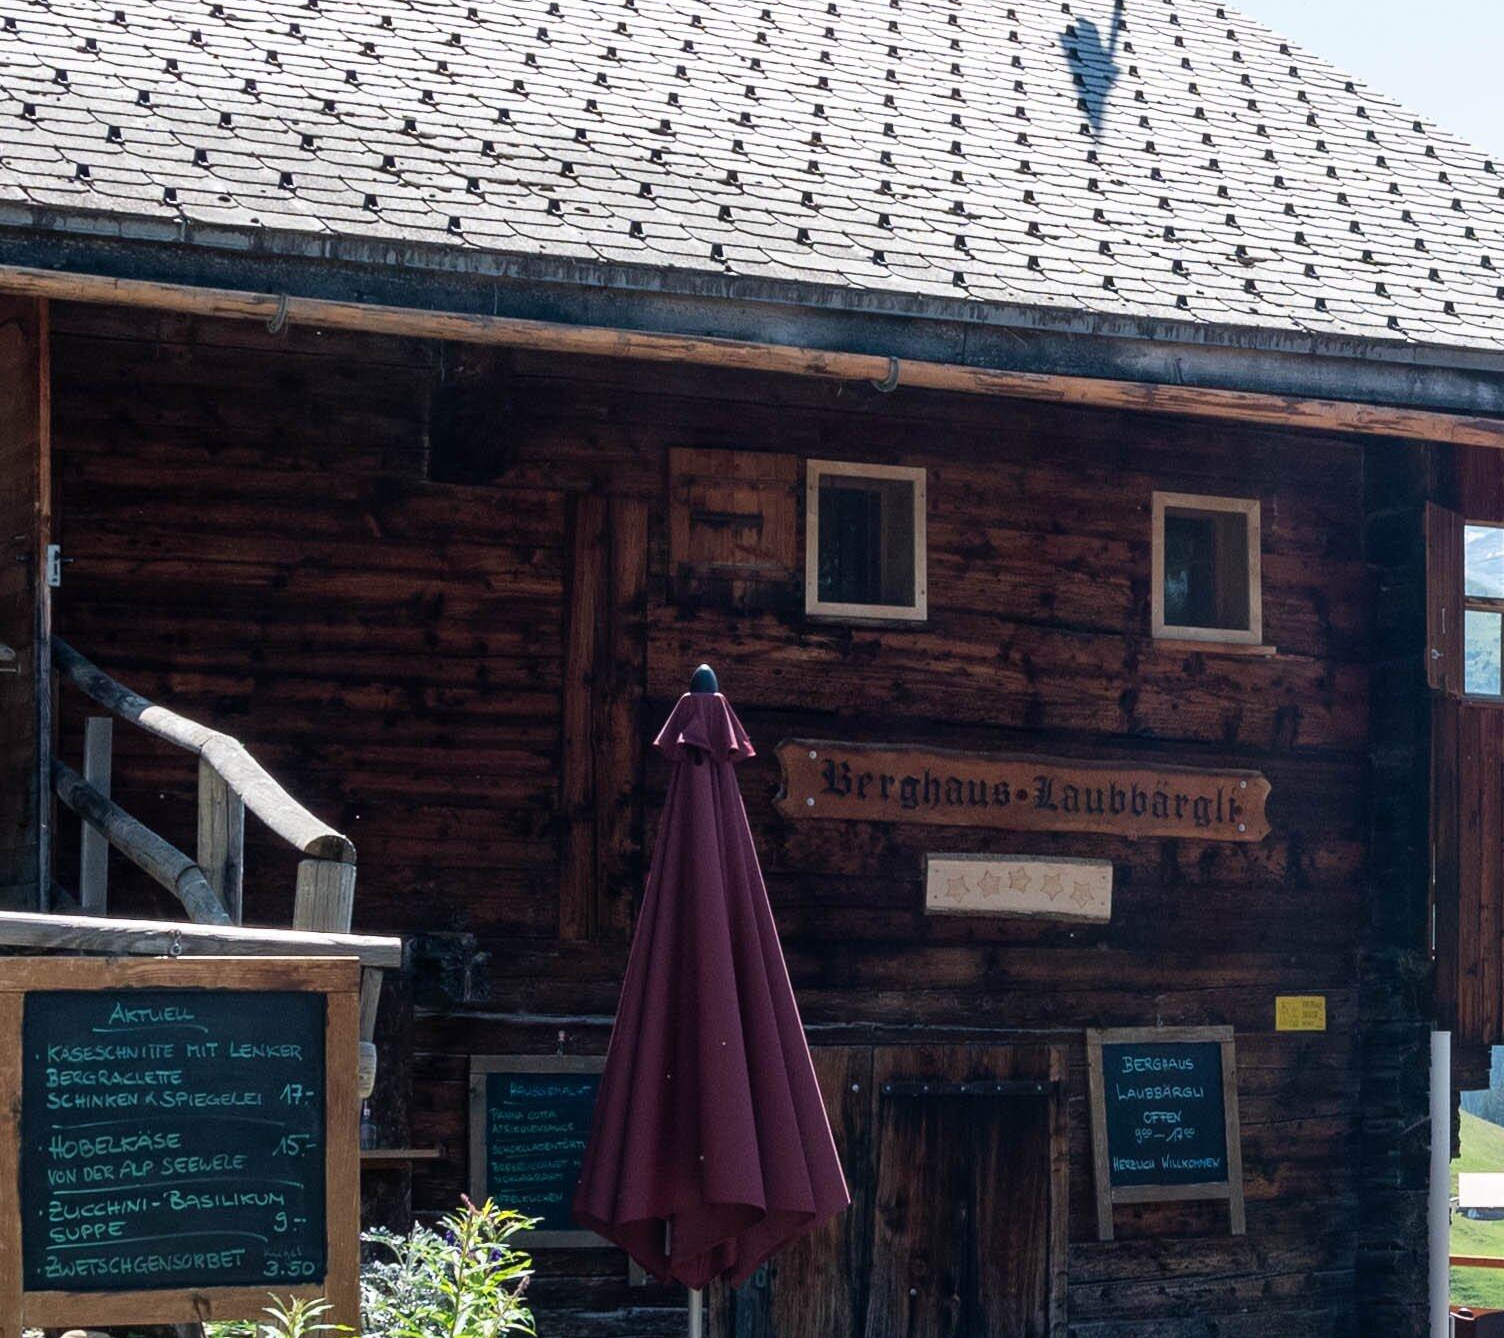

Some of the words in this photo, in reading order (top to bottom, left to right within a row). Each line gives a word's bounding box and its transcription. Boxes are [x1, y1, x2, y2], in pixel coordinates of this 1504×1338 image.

[821, 758, 1011, 809] Berghaus
[1032, 774, 1239, 827] Laubbärgli
[107, 1002, 196, 1026] AKTUELL
[186, 1041, 219, 1059] MIT
[229, 1040, 303, 1062] LENKER
[1121, 1056, 1194, 1074] BERGHAUS
[46, 1068, 183, 1087] BERGRACLETTE
[46, 1092, 139, 1110] SCHINKEN
[160, 1090, 263, 1108] SPIEGELEI
[1115, 1083, 1204, 1101] LAUBBÄRGLI
[1143, 1110, 1183, 1124] OFFEN
[48, 1130, 183, 1160] HOBELKÄSE
[47, 1168, 78, 1187] VON
[84, 1165, 115, 1182] DER
[119, 1160, 154, 1179] ALP
[48, 1221, 127, 1243] SUPPE
[45, 1249, 246, 1279] ZWETSCHGENSORBET
[263, 1260, 316, 1277] 3.50
